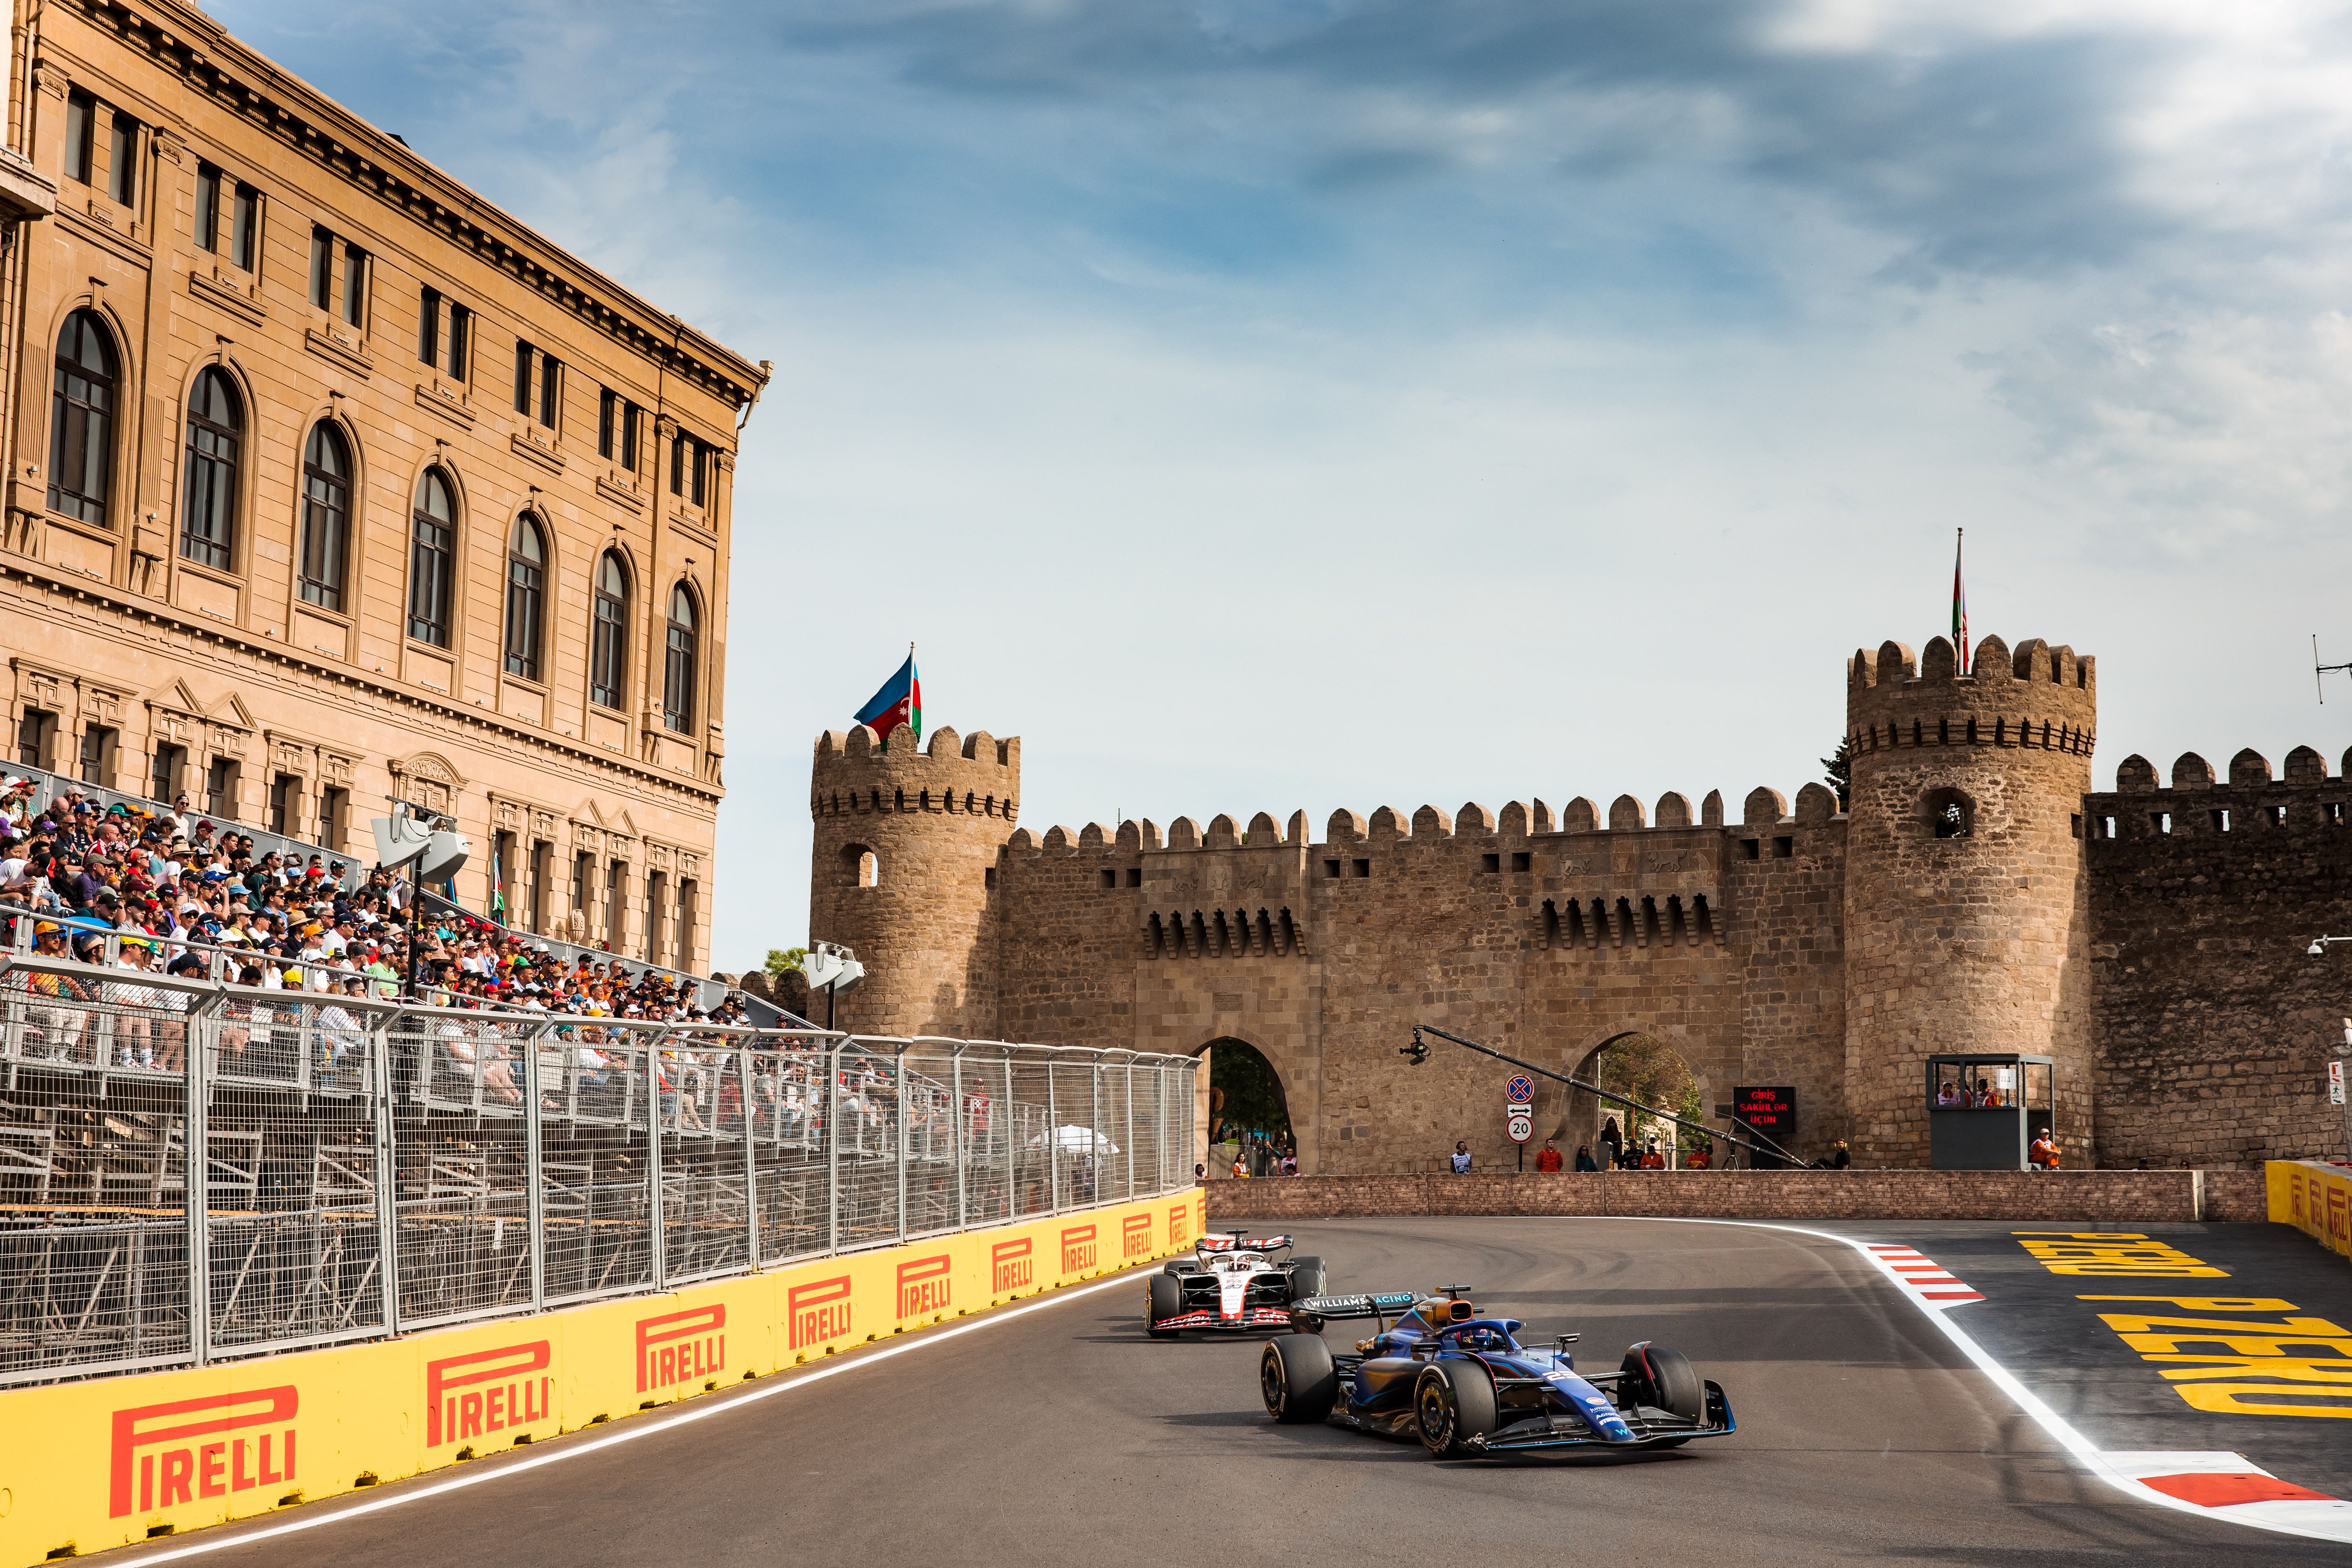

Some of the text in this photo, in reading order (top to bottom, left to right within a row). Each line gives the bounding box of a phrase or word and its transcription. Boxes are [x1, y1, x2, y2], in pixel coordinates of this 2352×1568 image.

[1740, 1100, 1788, 1112] SAKİNLƏR
[1751, 1089, 1776, 1102] GİRİŞ
[1513, 1123, 1529, 1134] 20
[1750, 1114, 1776, 1126] ÜÇÜN
[1123, 1213, 1151, 1258] PIRELLI
[1169, 1204, 1187, 1246] PIRELLI
[992, 1237, 1032, 1293] PIRELLI
[1061, 1224, 1096, 1274] PIRELLI
[897, 1254, 951, 1319] PIRELLI
[1310, 1297, 1366, 1308] WILLIAMS
[1376, 1294, 1411, 1304] ACING
[789, 1275, 851, 1350] PIRELLI
[1256, 1309, 1291, 1323] Gra
[636, 1303, 726, 1393] PIRELLI
[427, 1340, 551, 1448] PIRELLI
[1542, 1371, 1583, 1382] 23
[109, 1385, 299, 1519] PIRELLI
